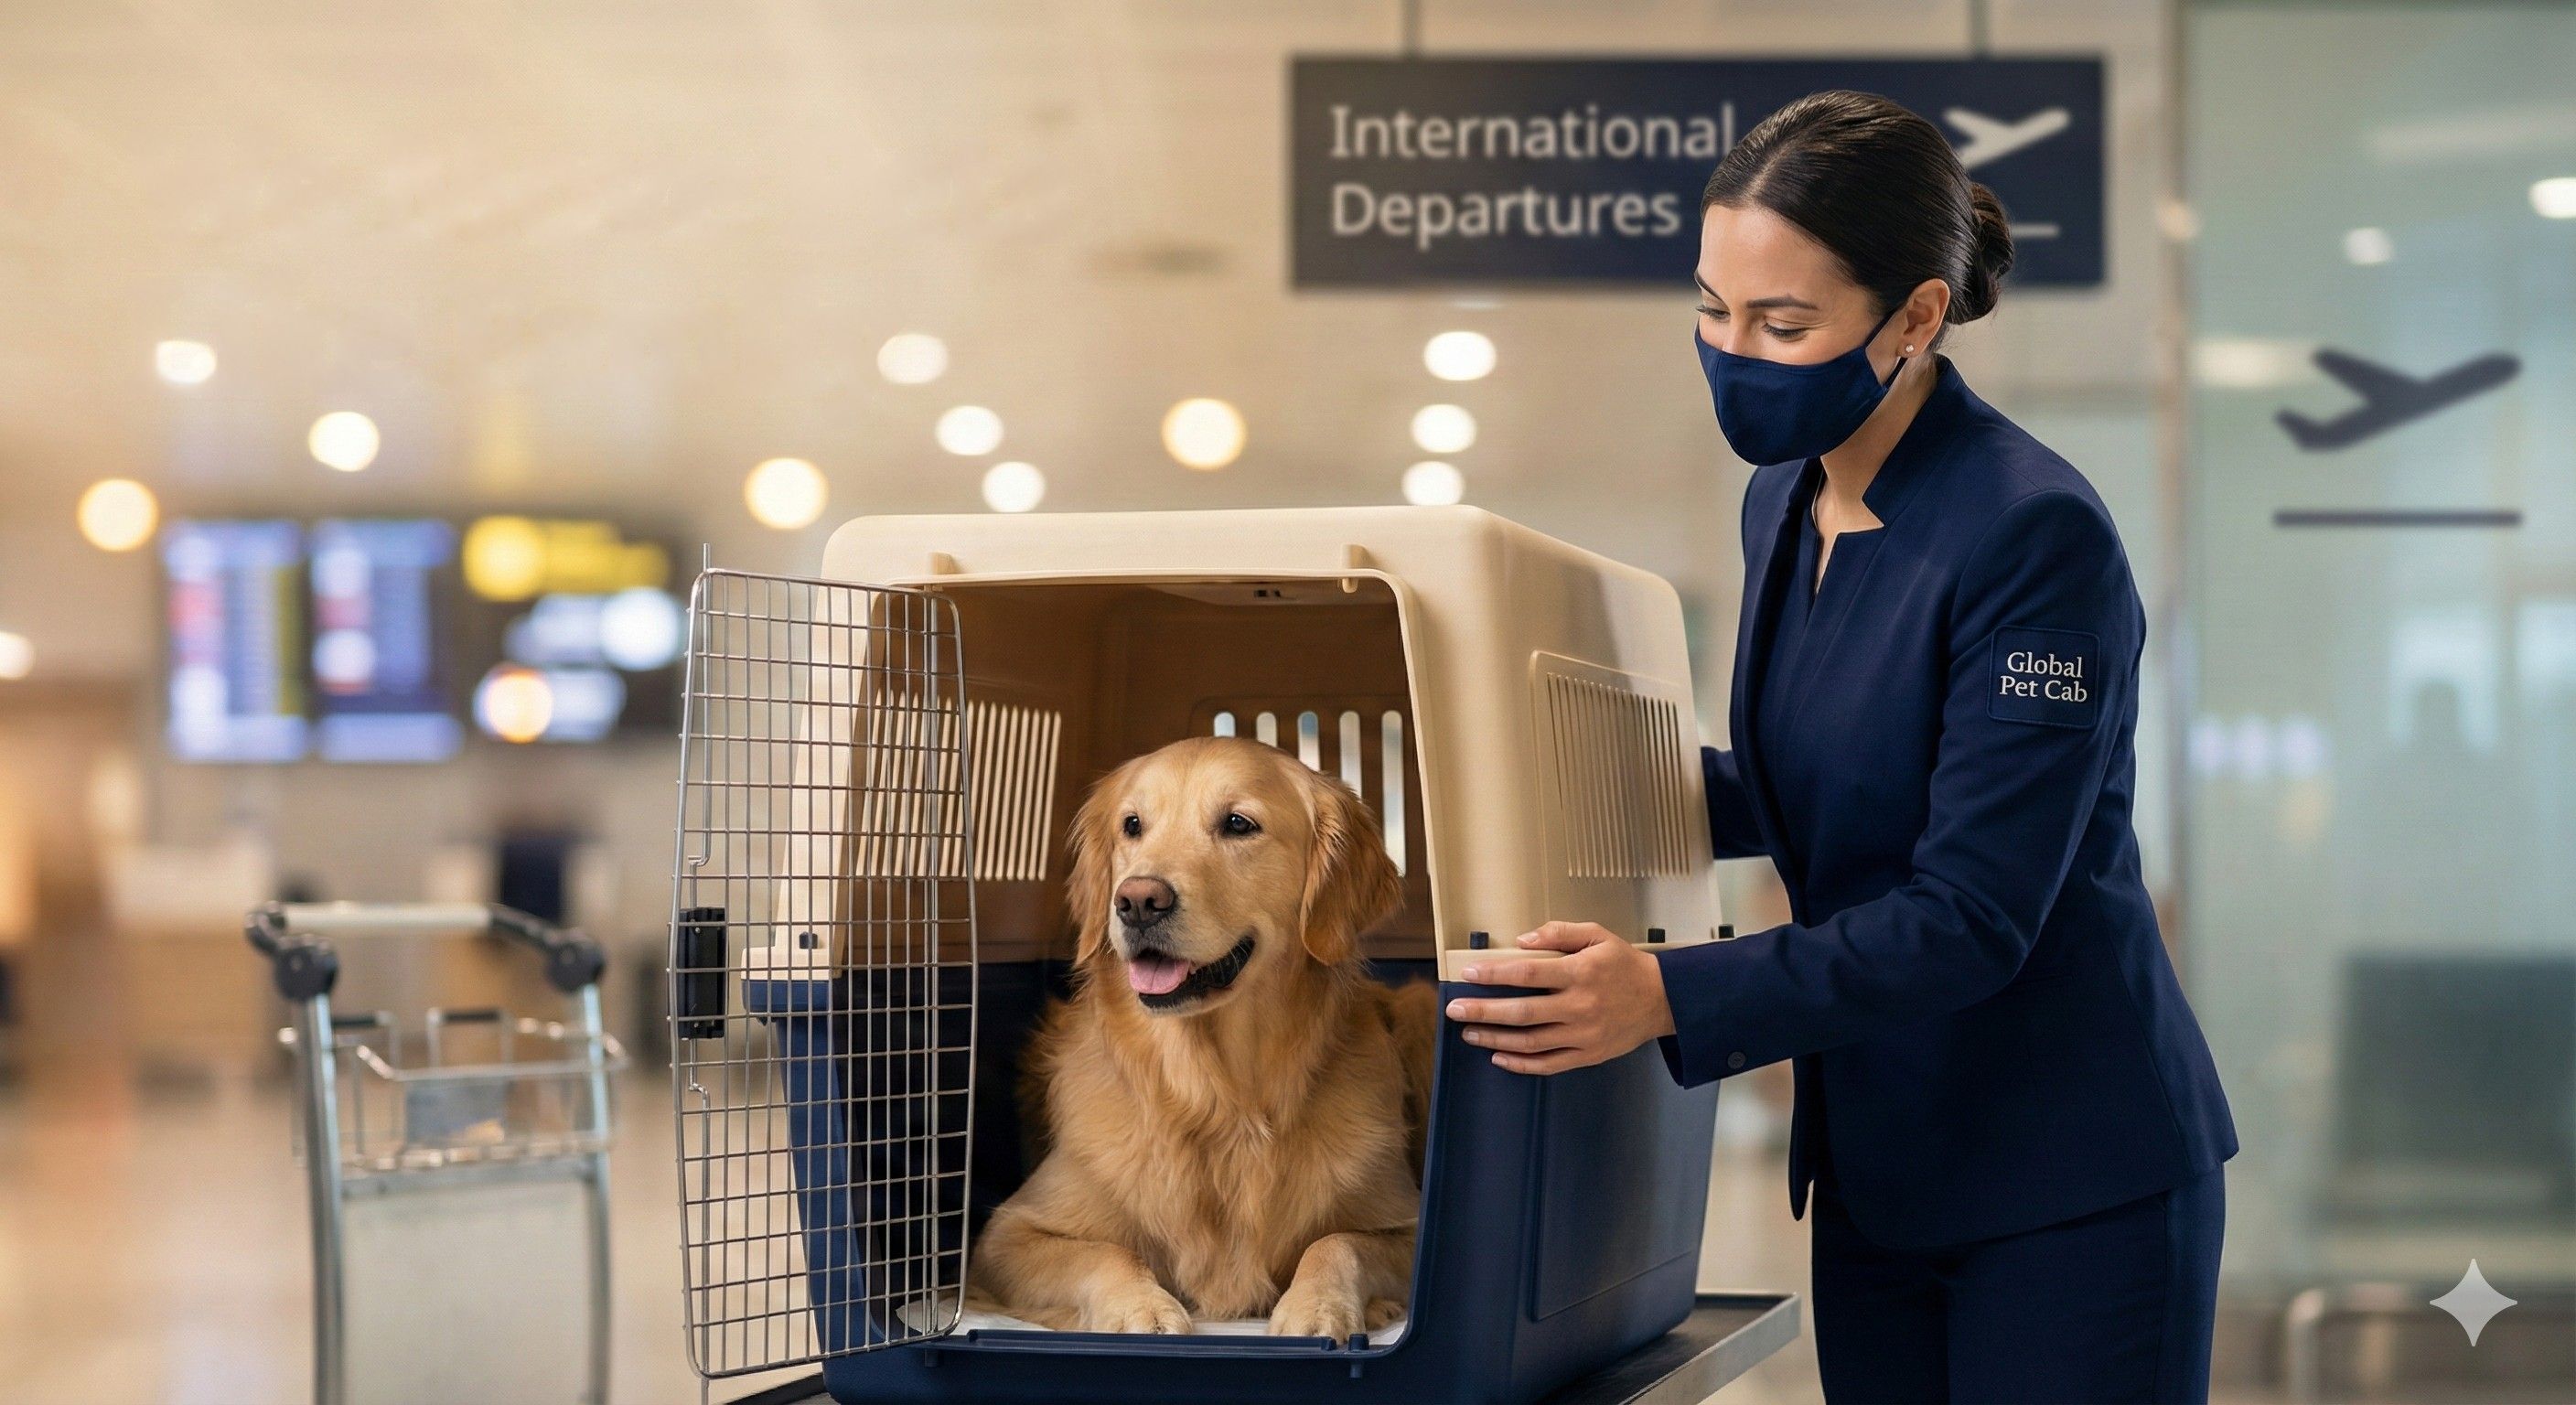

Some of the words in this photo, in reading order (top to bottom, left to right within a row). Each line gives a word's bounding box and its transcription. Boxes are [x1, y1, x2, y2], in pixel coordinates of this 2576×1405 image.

[1330, 103, 1735, 158] International
[1331, 184, 1681, 251] Departures
[2007, 651, 2082, 678] Global
[2000, 675, 2038, 697] Pet
[2045, 680, 2088, 702] Cab
